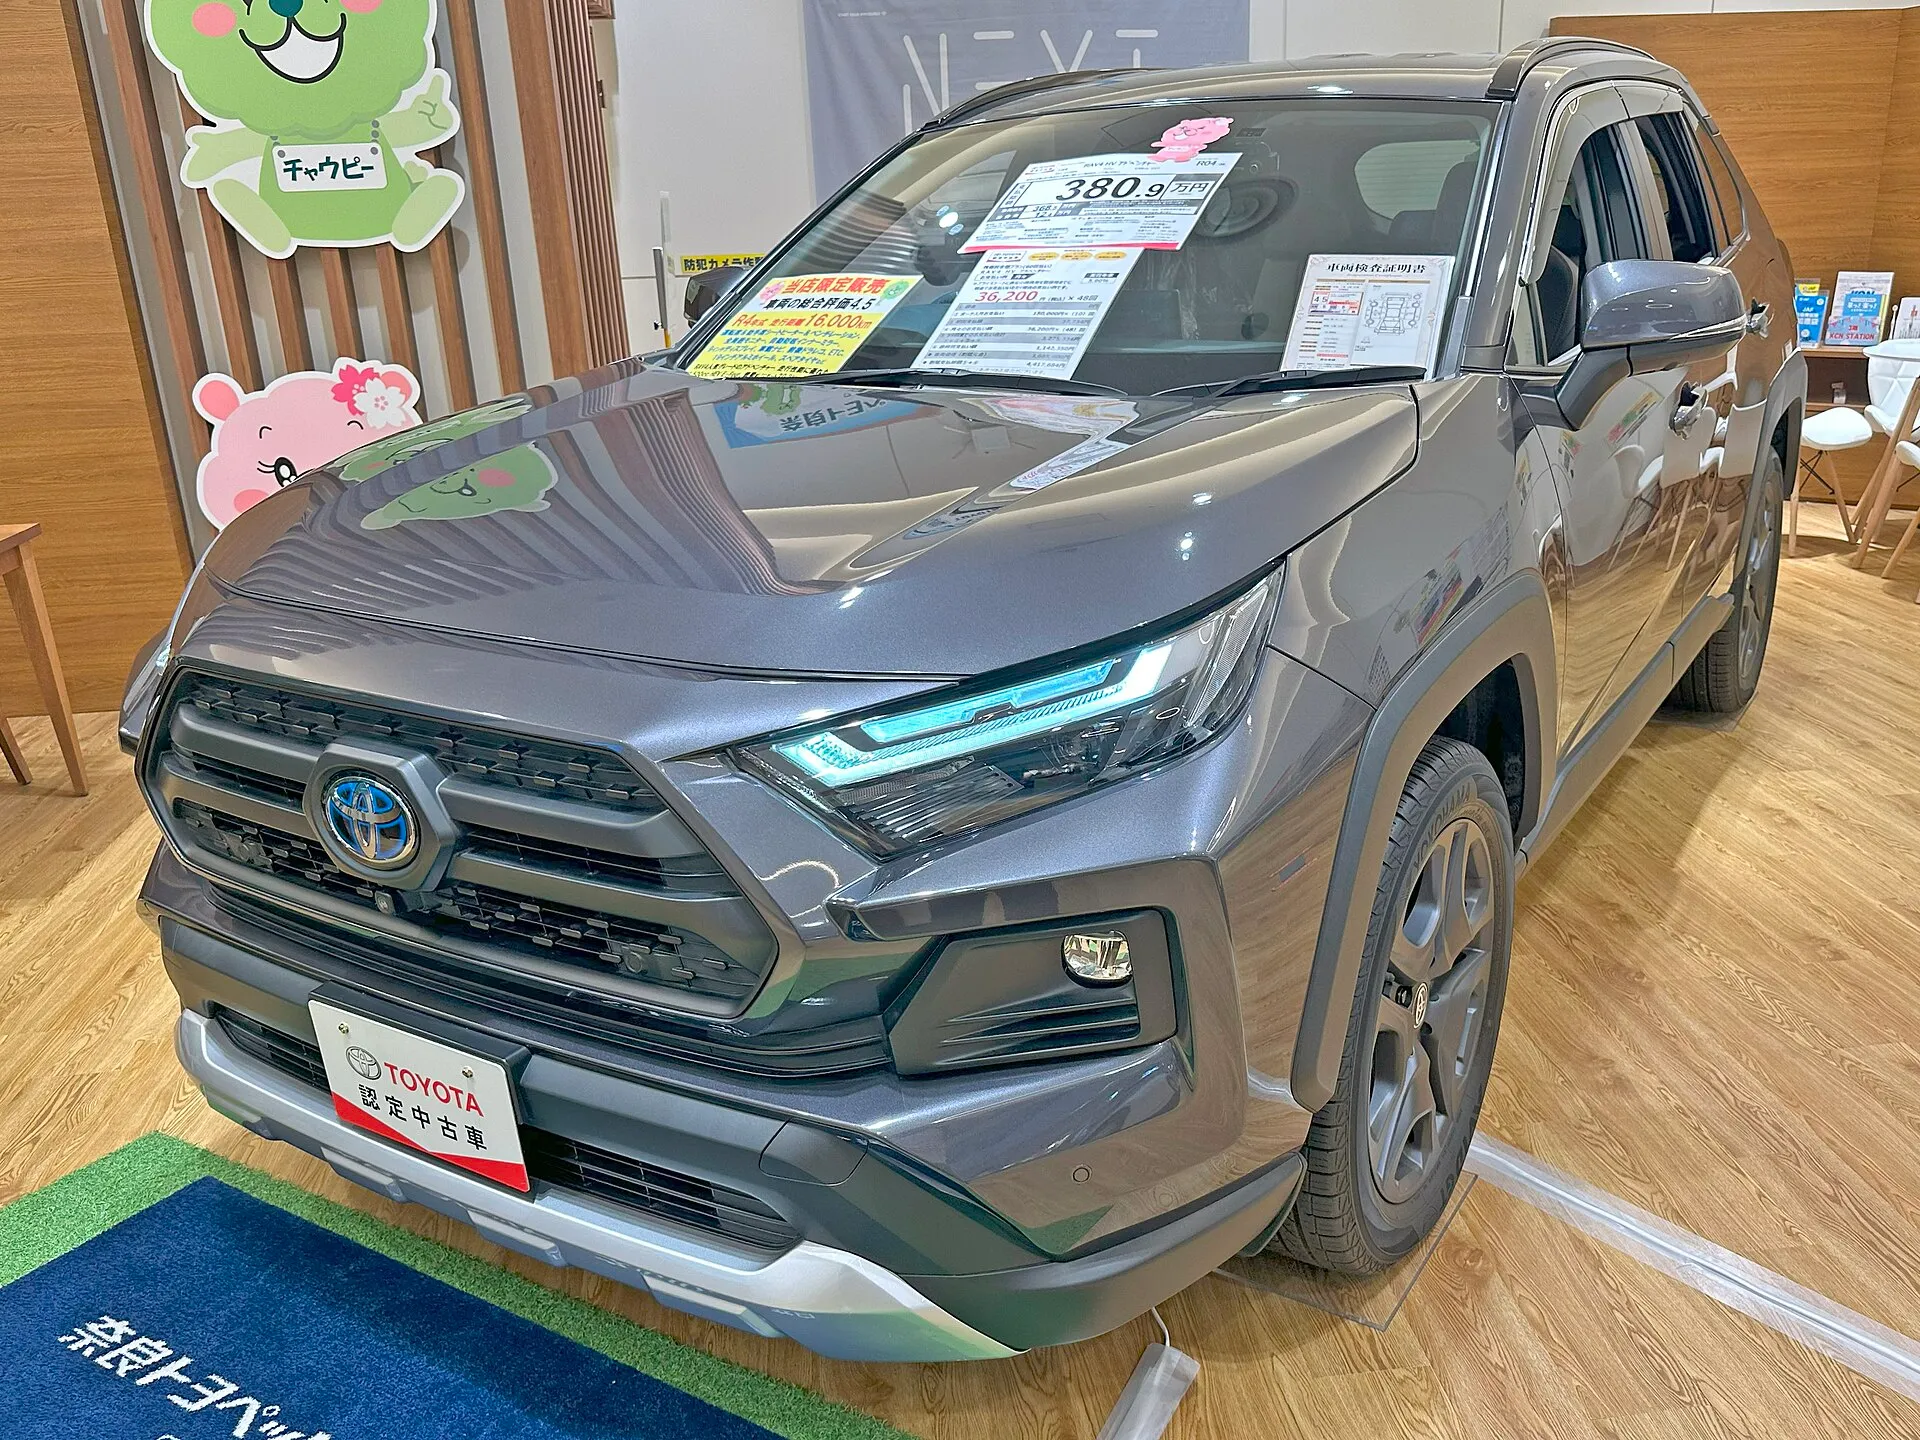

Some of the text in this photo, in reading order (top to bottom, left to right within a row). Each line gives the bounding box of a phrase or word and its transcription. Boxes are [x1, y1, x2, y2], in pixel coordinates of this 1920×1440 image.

[283, 156, 374, 181] チャウピー
[1056, 177, 1209, 200] 380.9 万円
[1327, 263, 1426, 274] 車両検査証明書
[782, 277, 888, 294] 当店限定販売
[763, 297, 876, 310] 車両の総合評価4.5
[975, 291, 1039, 302] 36,200
[384, 1062, 484, 1118] TOYOTA
[358, 1084, 487, 1150] 認定中古車
